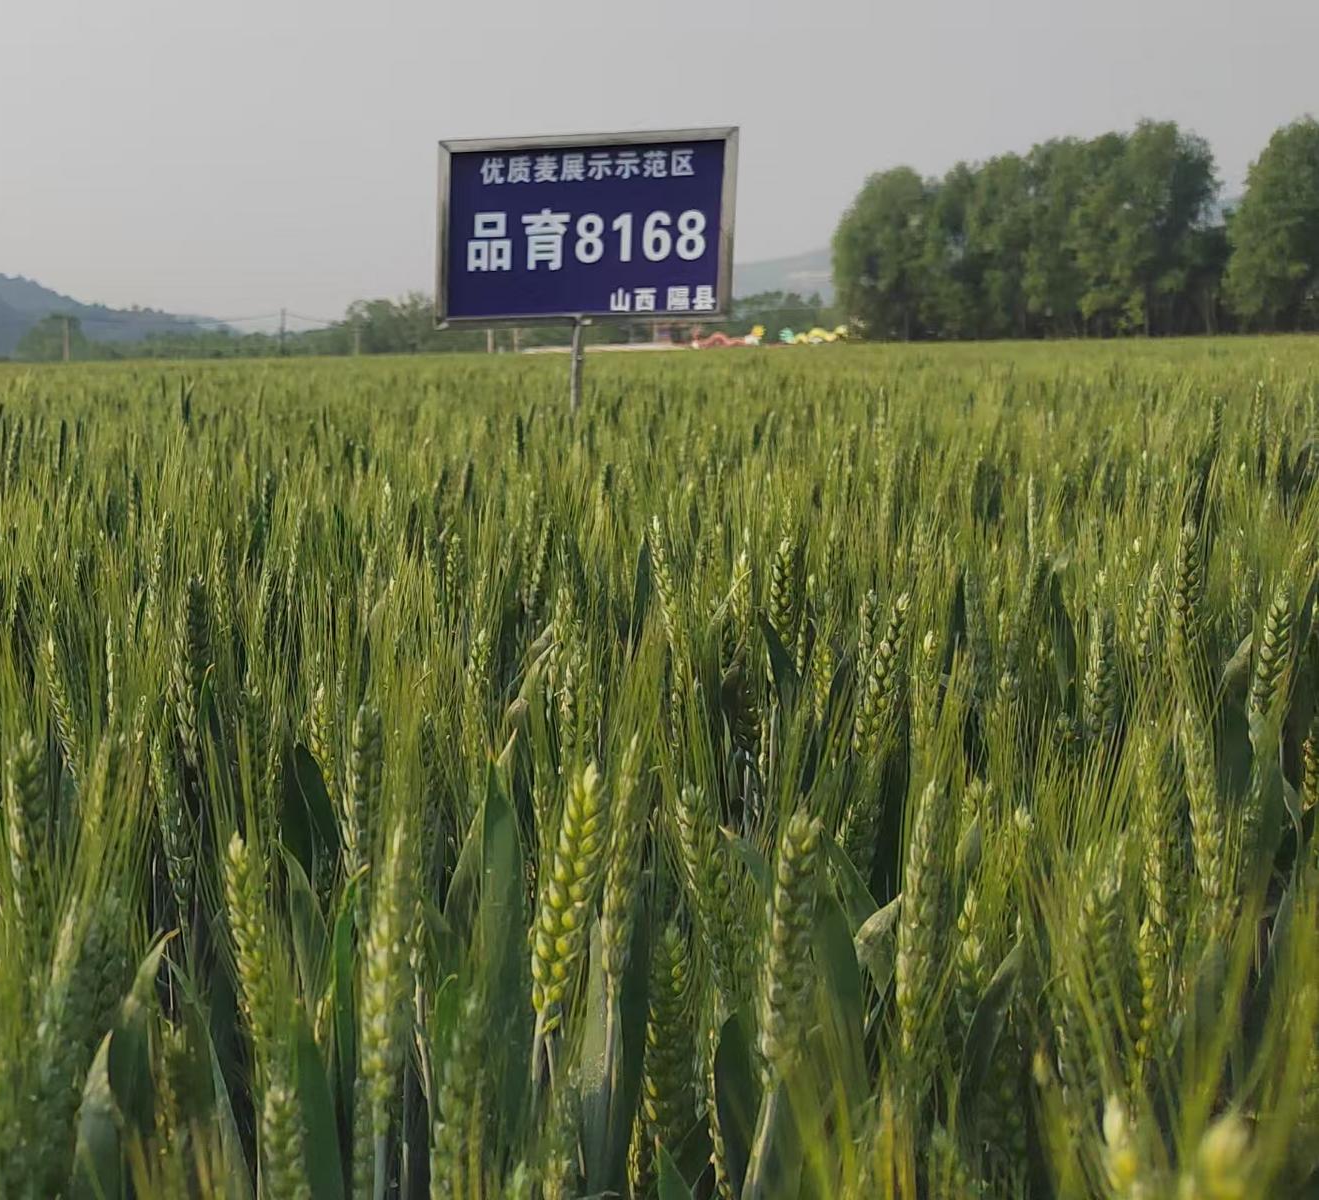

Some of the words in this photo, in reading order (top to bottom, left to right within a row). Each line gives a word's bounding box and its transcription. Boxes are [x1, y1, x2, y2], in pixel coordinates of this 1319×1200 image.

[480, 149, 695, 185] 优质麦展示示范区
[467, 208, 706, 272] 品育8168
[610, 287, 657, 312] 山西
